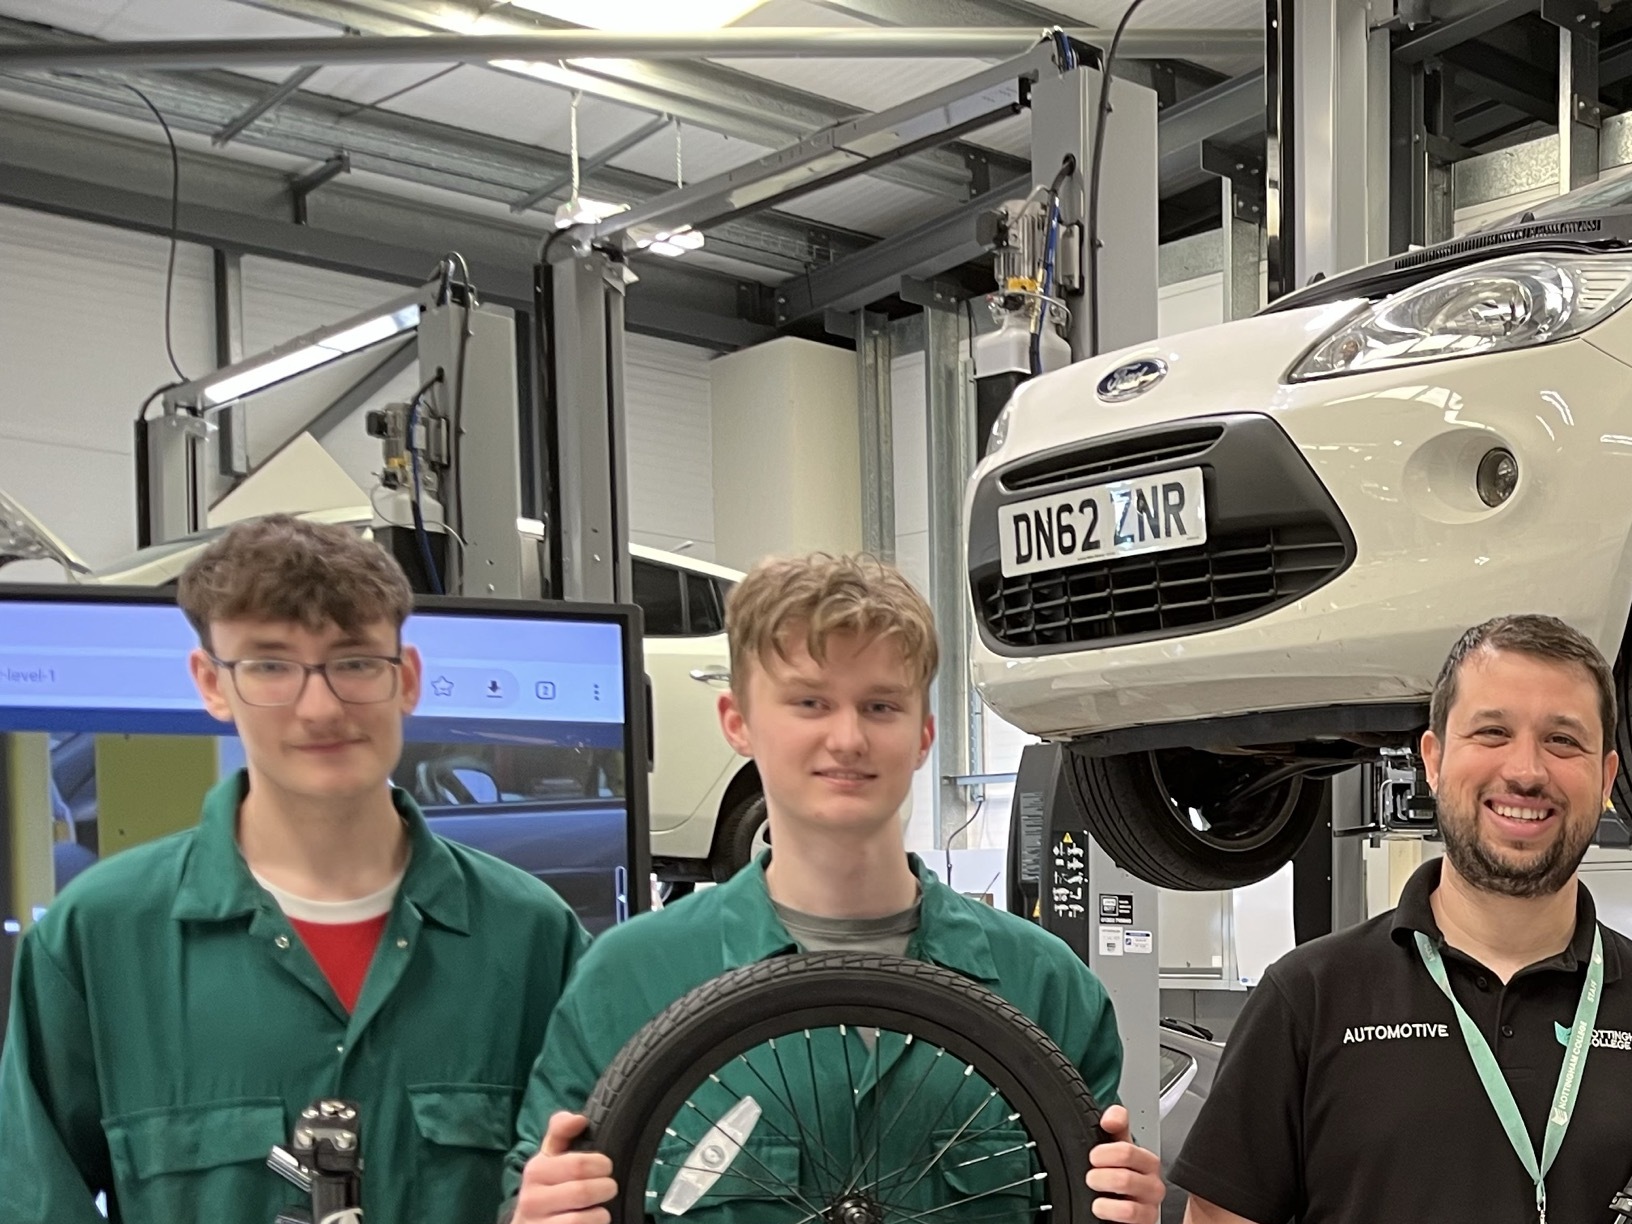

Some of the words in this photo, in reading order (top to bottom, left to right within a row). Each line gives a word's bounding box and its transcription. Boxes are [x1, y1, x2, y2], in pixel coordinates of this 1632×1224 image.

[1013, 498, 1100, 565] DN62
[1109, 481, 1187, 546] ZNR
[1587, 981, 1598, 1003] STAFF
[1343, 1023, 1450, 1044] AUTOMOTIVE
[1591, 1038, 1632, 1050] OLLEGE
[1558, 1056, 1579, 1110] NOTTINGHAM
[1572, 1021, 1588, 1055] COLLEGE
